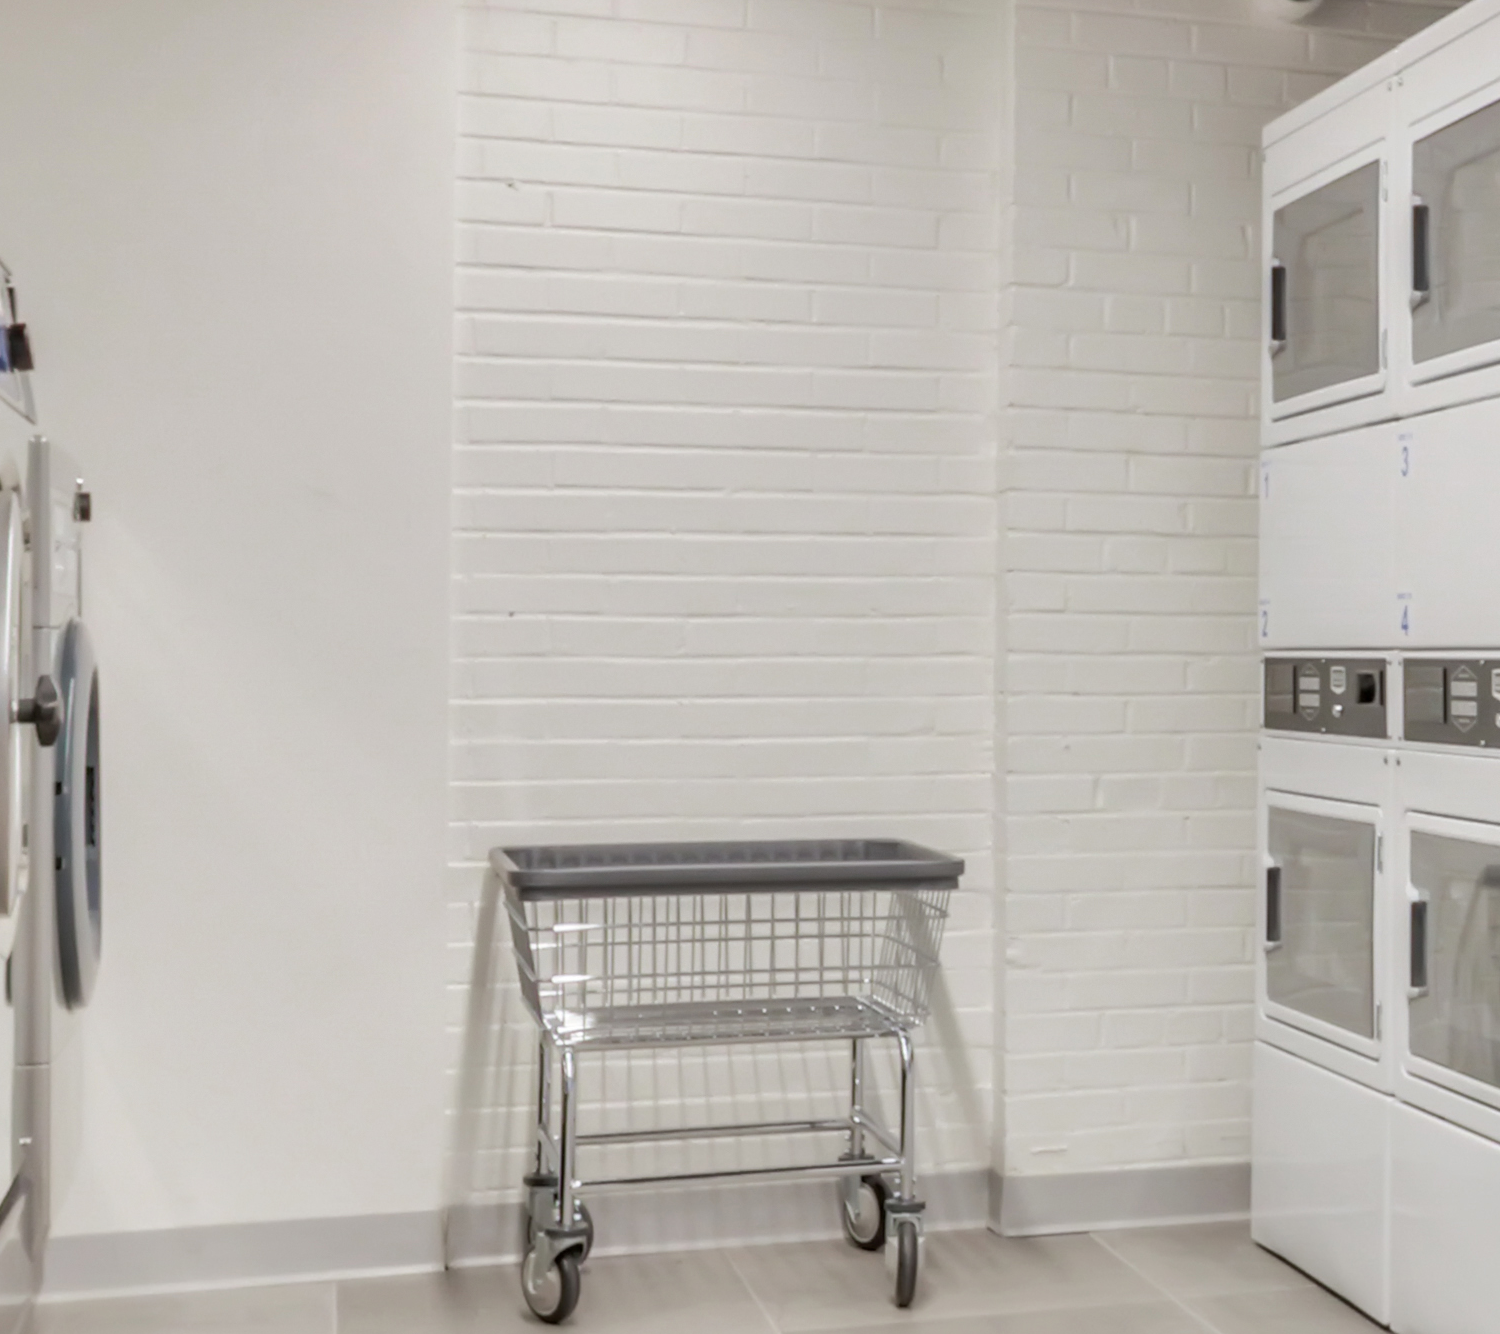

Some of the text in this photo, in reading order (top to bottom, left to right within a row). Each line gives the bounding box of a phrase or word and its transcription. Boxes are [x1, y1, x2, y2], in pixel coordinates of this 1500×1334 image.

[1401, 446, 1409, 477] 3
[1262, 610, 1268, 638] 2
[1400, 605, 1409, 636] 4
